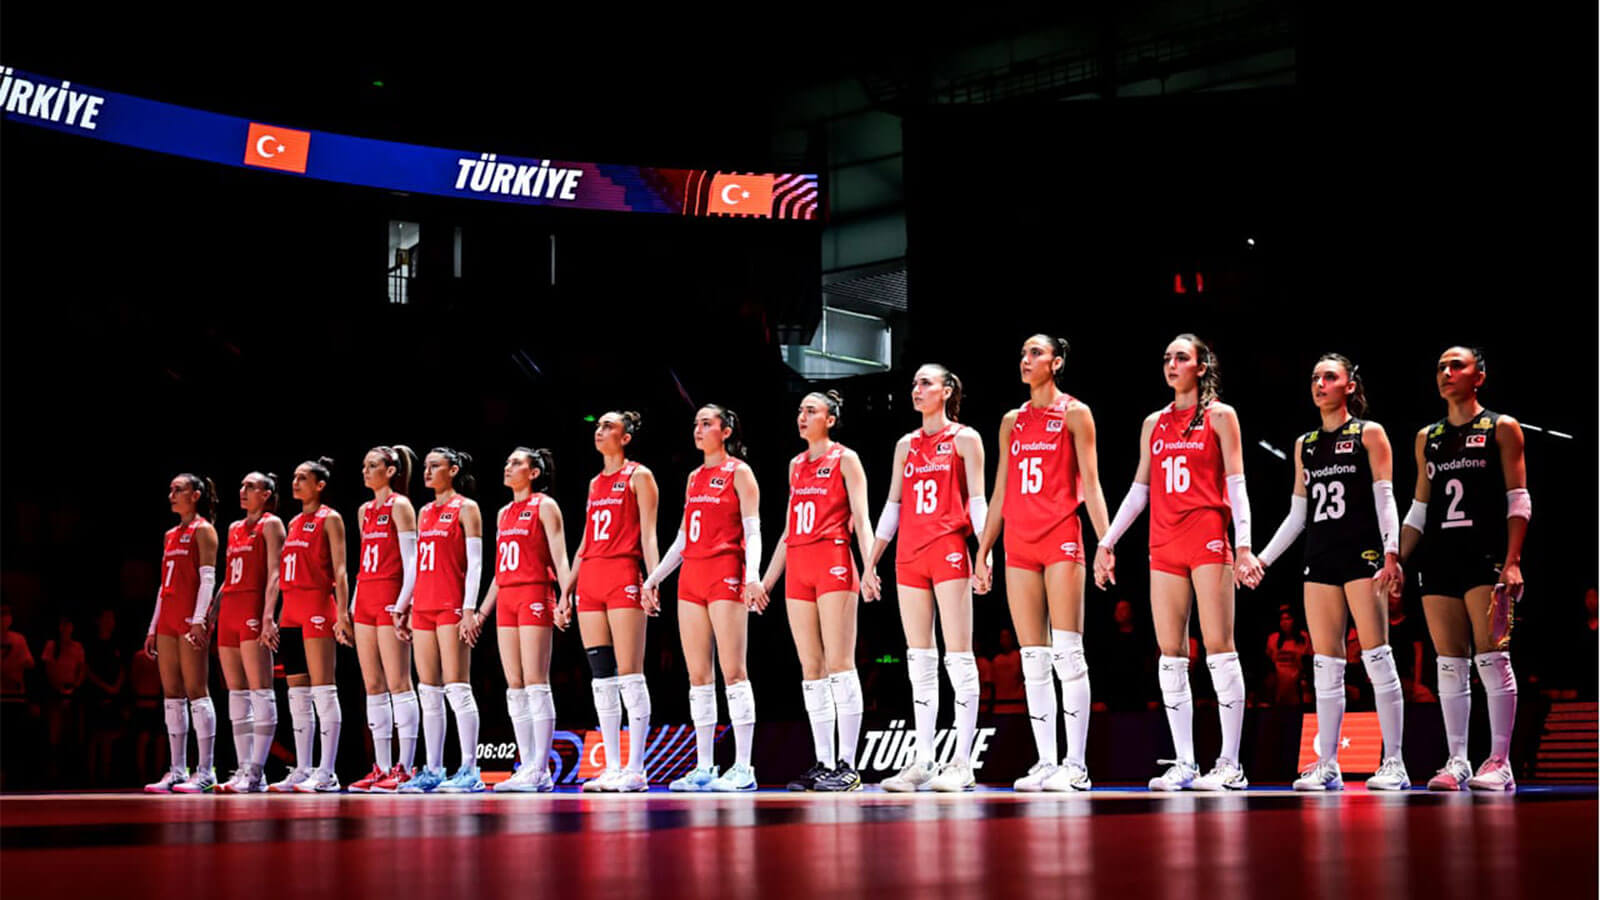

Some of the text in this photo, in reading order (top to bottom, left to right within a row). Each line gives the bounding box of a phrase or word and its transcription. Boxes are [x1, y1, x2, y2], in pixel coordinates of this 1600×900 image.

[455, 152, 583, 200] TÜRKİYE
[1018, 457, 1043, 495] 15
[1161, 455, 1191, 494] 16
[1311, 464, 1357, 478] vodafone
[1437, 457, 1487, 471] vodafone
[913, 479, 938, 515] 13
[1312, 481, 1346, 523] 23
[1445, 478, 1465, 520] 2
[591, 509, 611, 541] 12
[689, 510, 701, 542] 6
[794, 500, 816, 536] 10
[230, 556, 243, 585] 19
[283, 552, 297, 582] 11
[362, 543, 379, 573] 41
[419, 541, 435, 571] 21
[499, 541, 520, 572] 20
[164, 559, 175, 588] 7
[476, 742, 517, 760] 06:02
[857, 719, 997, 771] TÜRİE
